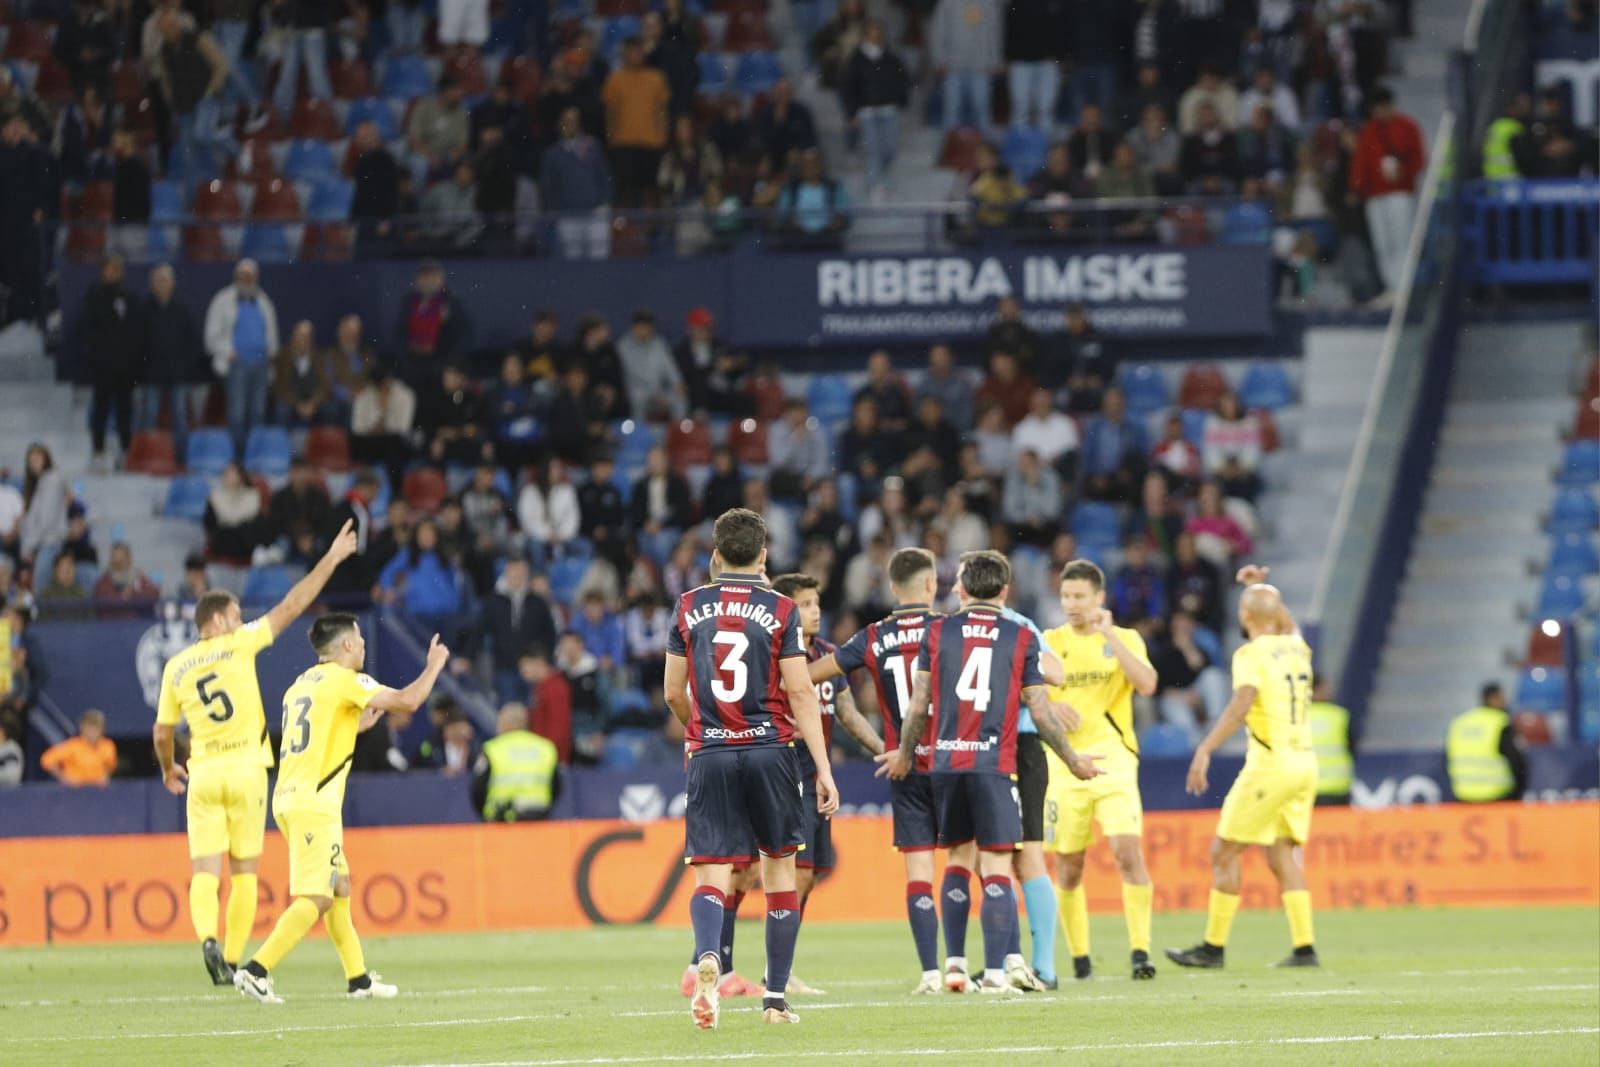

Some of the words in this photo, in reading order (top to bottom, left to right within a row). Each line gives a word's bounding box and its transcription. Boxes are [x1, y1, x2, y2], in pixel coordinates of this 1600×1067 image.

[817, 257, 1013, 305] RIBERA
[1022, 253, 1187, 301] IMSKE
[684, 601, 723, 630] ÁLEX
[726, 601, 782, 634] MUÑOZ
[961, 624, 1000, 641] DELA
[883, 628, 926, 650] MART
[710, 630, 749, 703] 3
[884, 655, 924, 719] 1
[955, 646, 993, 712] 4
[196, 672, 234, 722] 5
[703, 725, 768, 739] sesderma
[936, 738, 991, 751] sesderma
[330, 843, 341, 867] 2
[44, 870, 449, 943] proeos
